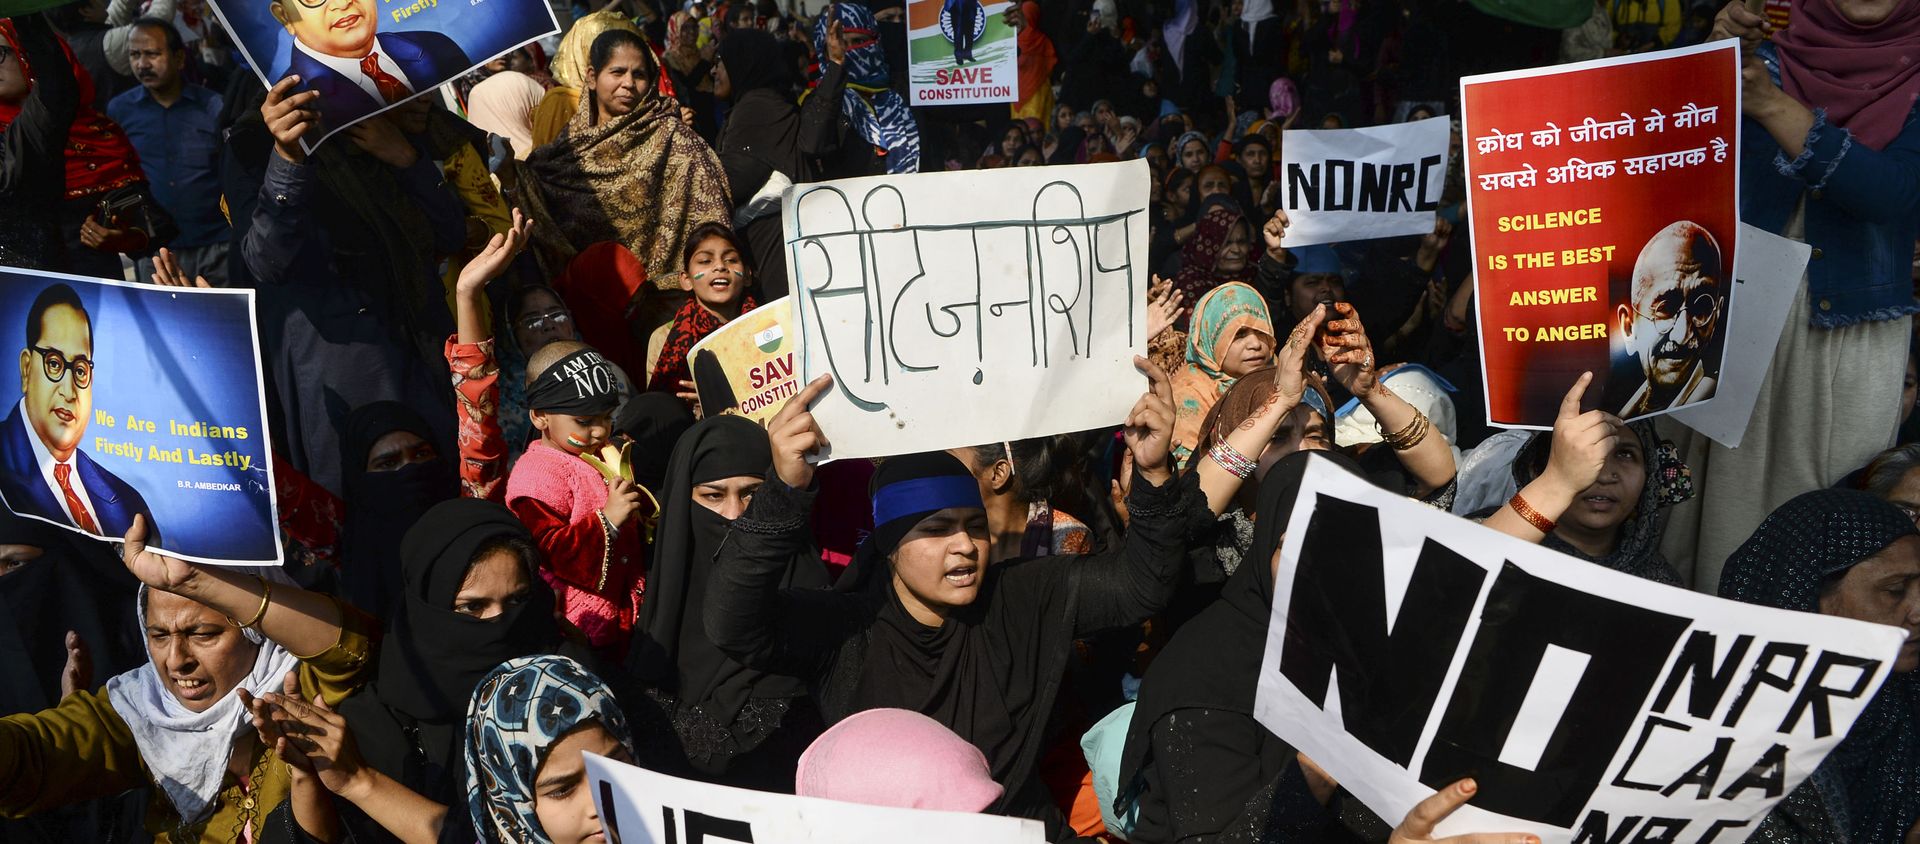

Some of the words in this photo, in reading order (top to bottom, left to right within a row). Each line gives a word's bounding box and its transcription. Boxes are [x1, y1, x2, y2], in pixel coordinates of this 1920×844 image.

[936, 67, 993, 86] SAVE
[919, 86, 1010, 100] CONSTITUTION
[1476, 128, 1523, 155] क्रोध
[1530, 122, 1561, 148] को
[1568, 112, 1636, 142] जीतने
[1643, 109, 1666, 133] मे
[1673, 102, 1718, 129] मौन
[1478, 163, 1538, 191] सबसे
[1546, 158, 1616, 184] अधिक
[1623, 147, 1707, 176] सहायक
[1710, 136, 1728, 163] है
[1498, 207, 1602, 232] SCILENCE
[1488, 255, 1507, 270] IS
[1513, 252, 1555, 269] THE
[1562, 245, 1616, 266] BEST
[1509, 286, 1597, 306] ANSWER
[1503, 327, 1529, 342] TO
[1535, 323, 1607, 342] ANGER
[553, 371, 562, 382] I
[563, 356, 588, 378] AM
[95, 409, 115, 427] We
[127, 415, 156, 433] Are
[170, 419, 249, 440] Indians
[95, 437, 143, 462] Firstly
[148, 445, 183, 463] And
[188, 448, 251, 471] Lastly
[177, 480, 193, 489] B.R.
[194, 481, 241, 491] AMBEDKAR
[1279, 491, 1694, 829] NO
[1650, 630, 1883, 739] NPR
[1610, 715, 1790, 801] CAA
